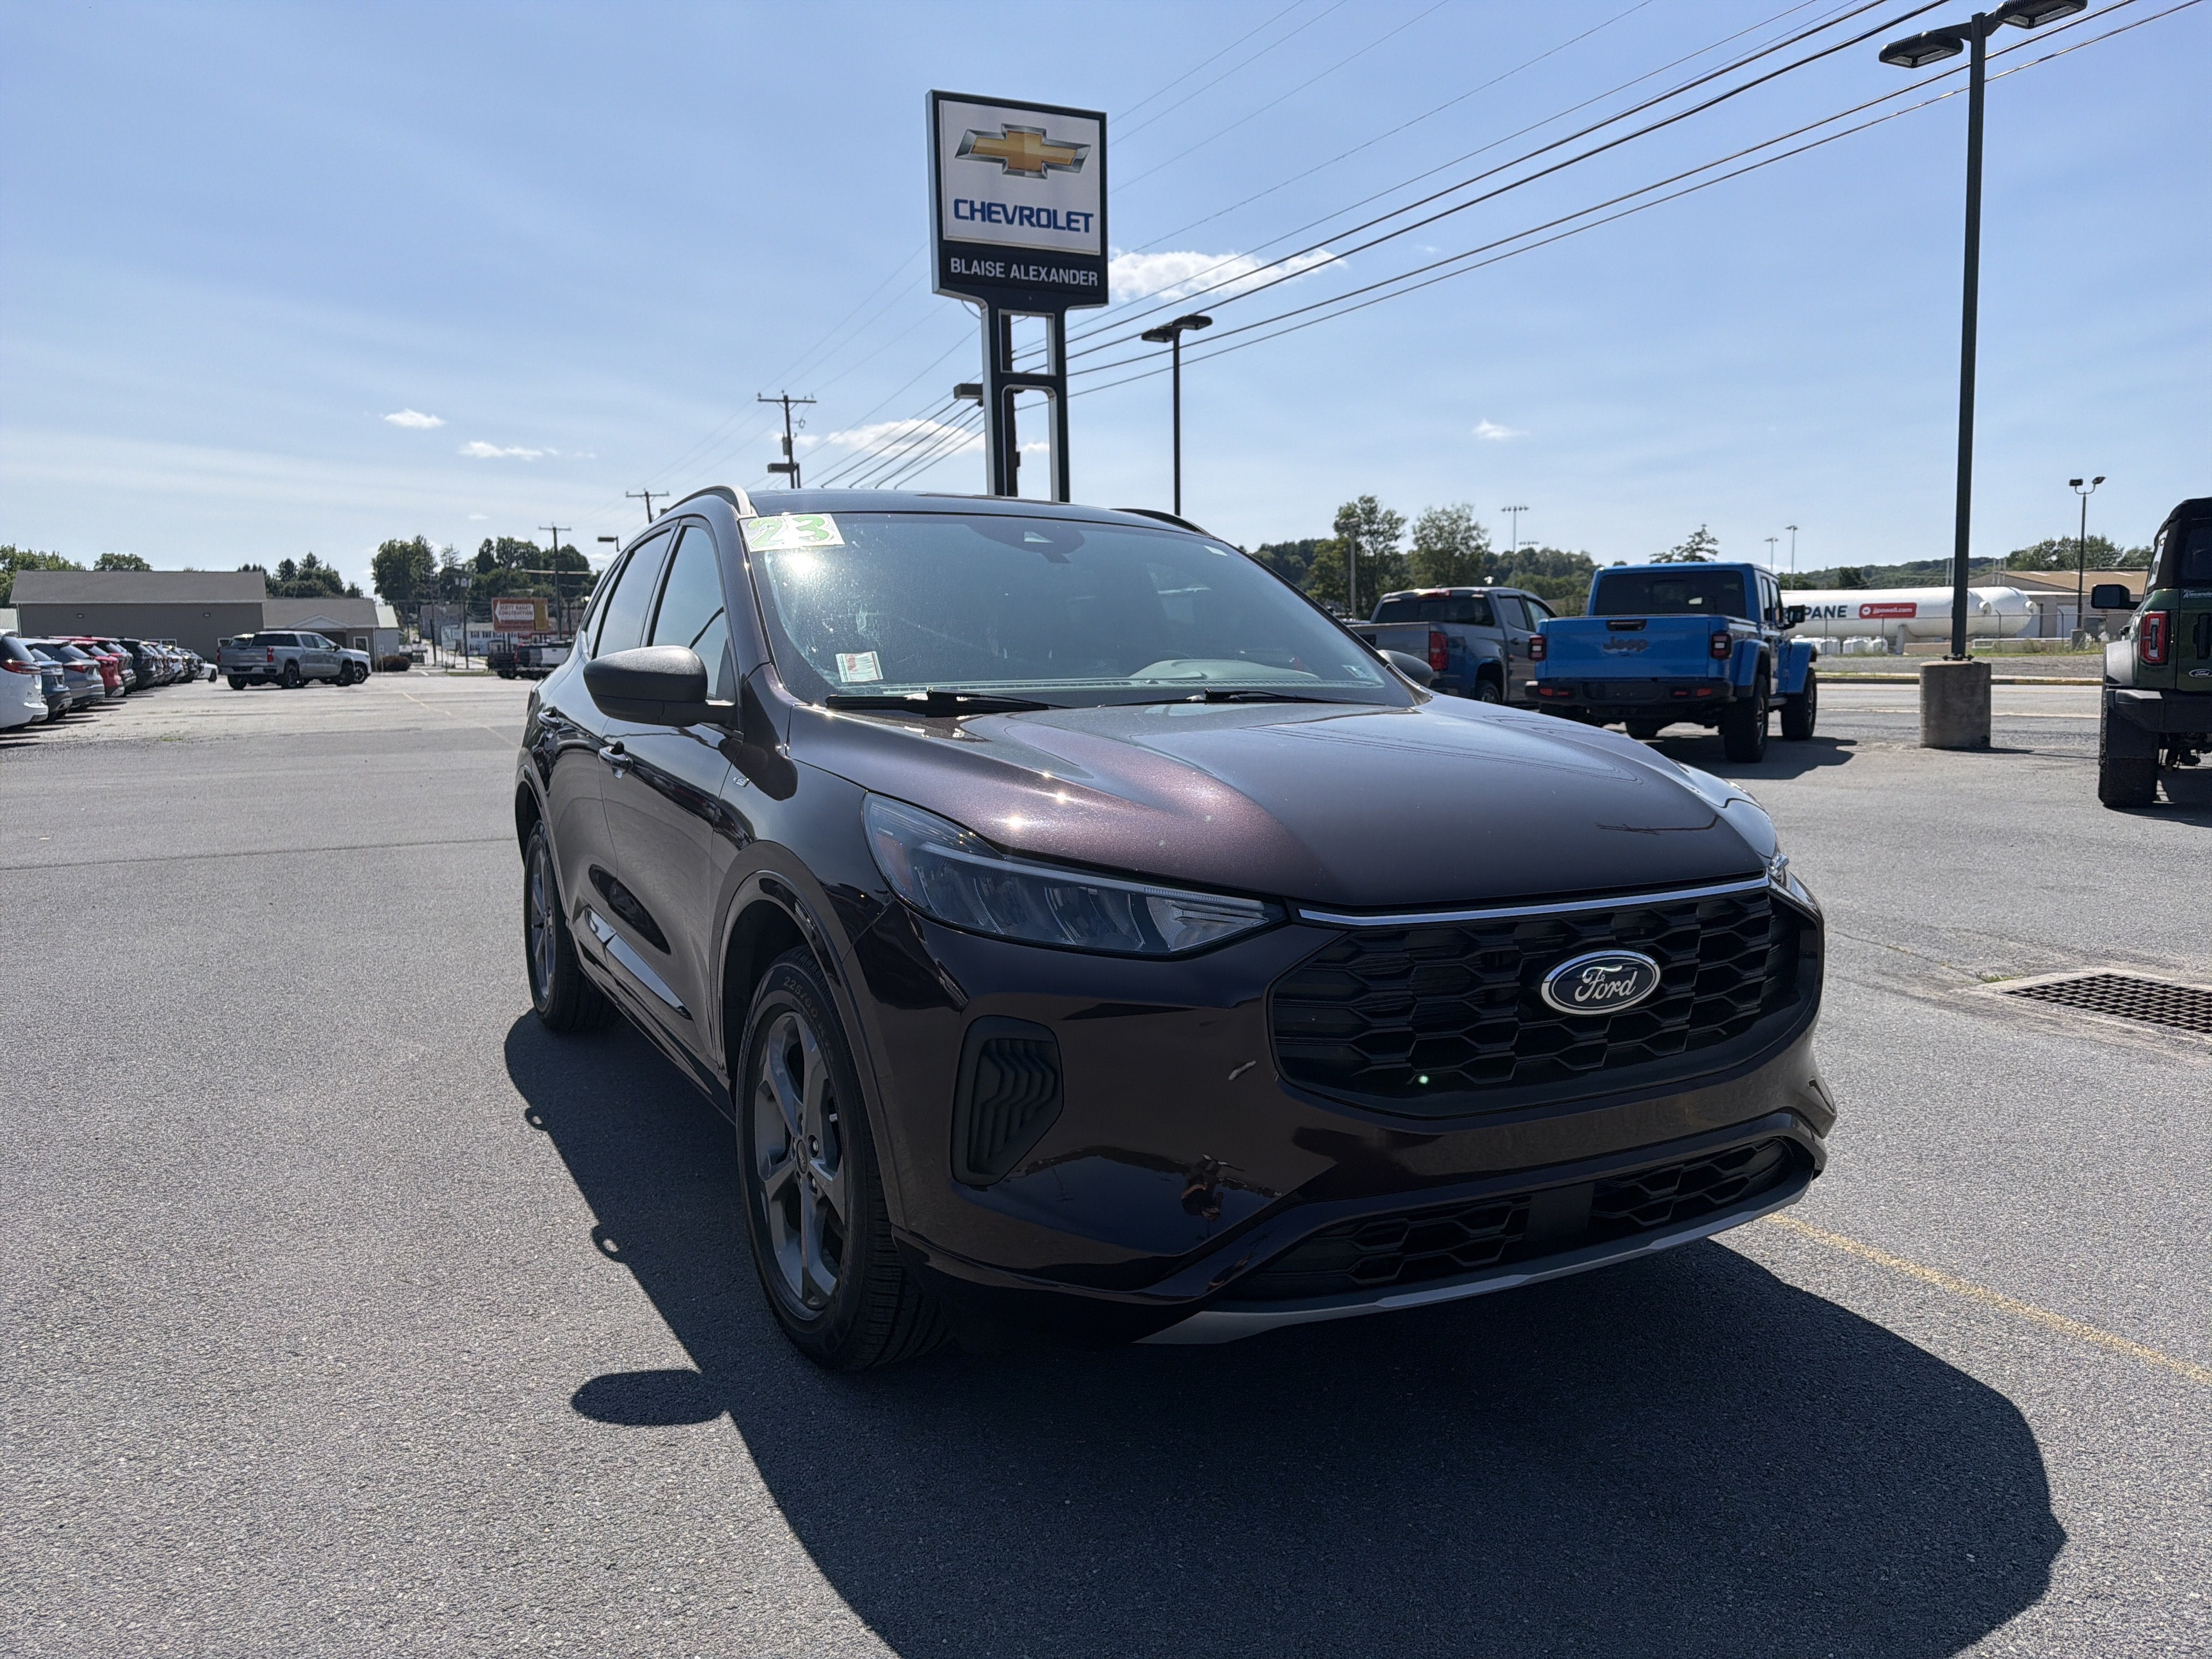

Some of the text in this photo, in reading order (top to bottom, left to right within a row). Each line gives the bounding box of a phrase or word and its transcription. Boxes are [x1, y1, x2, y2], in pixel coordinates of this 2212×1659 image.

[953, 198, 1094, 233] CHEVROLET
[950, 257, 1098, 286] BLAISE ALEXANDER
[748, 515, 833, 549] 23
[1602, 636, 1648, 652] Jeep
[1575, 965, 1638, 1002] Ford
